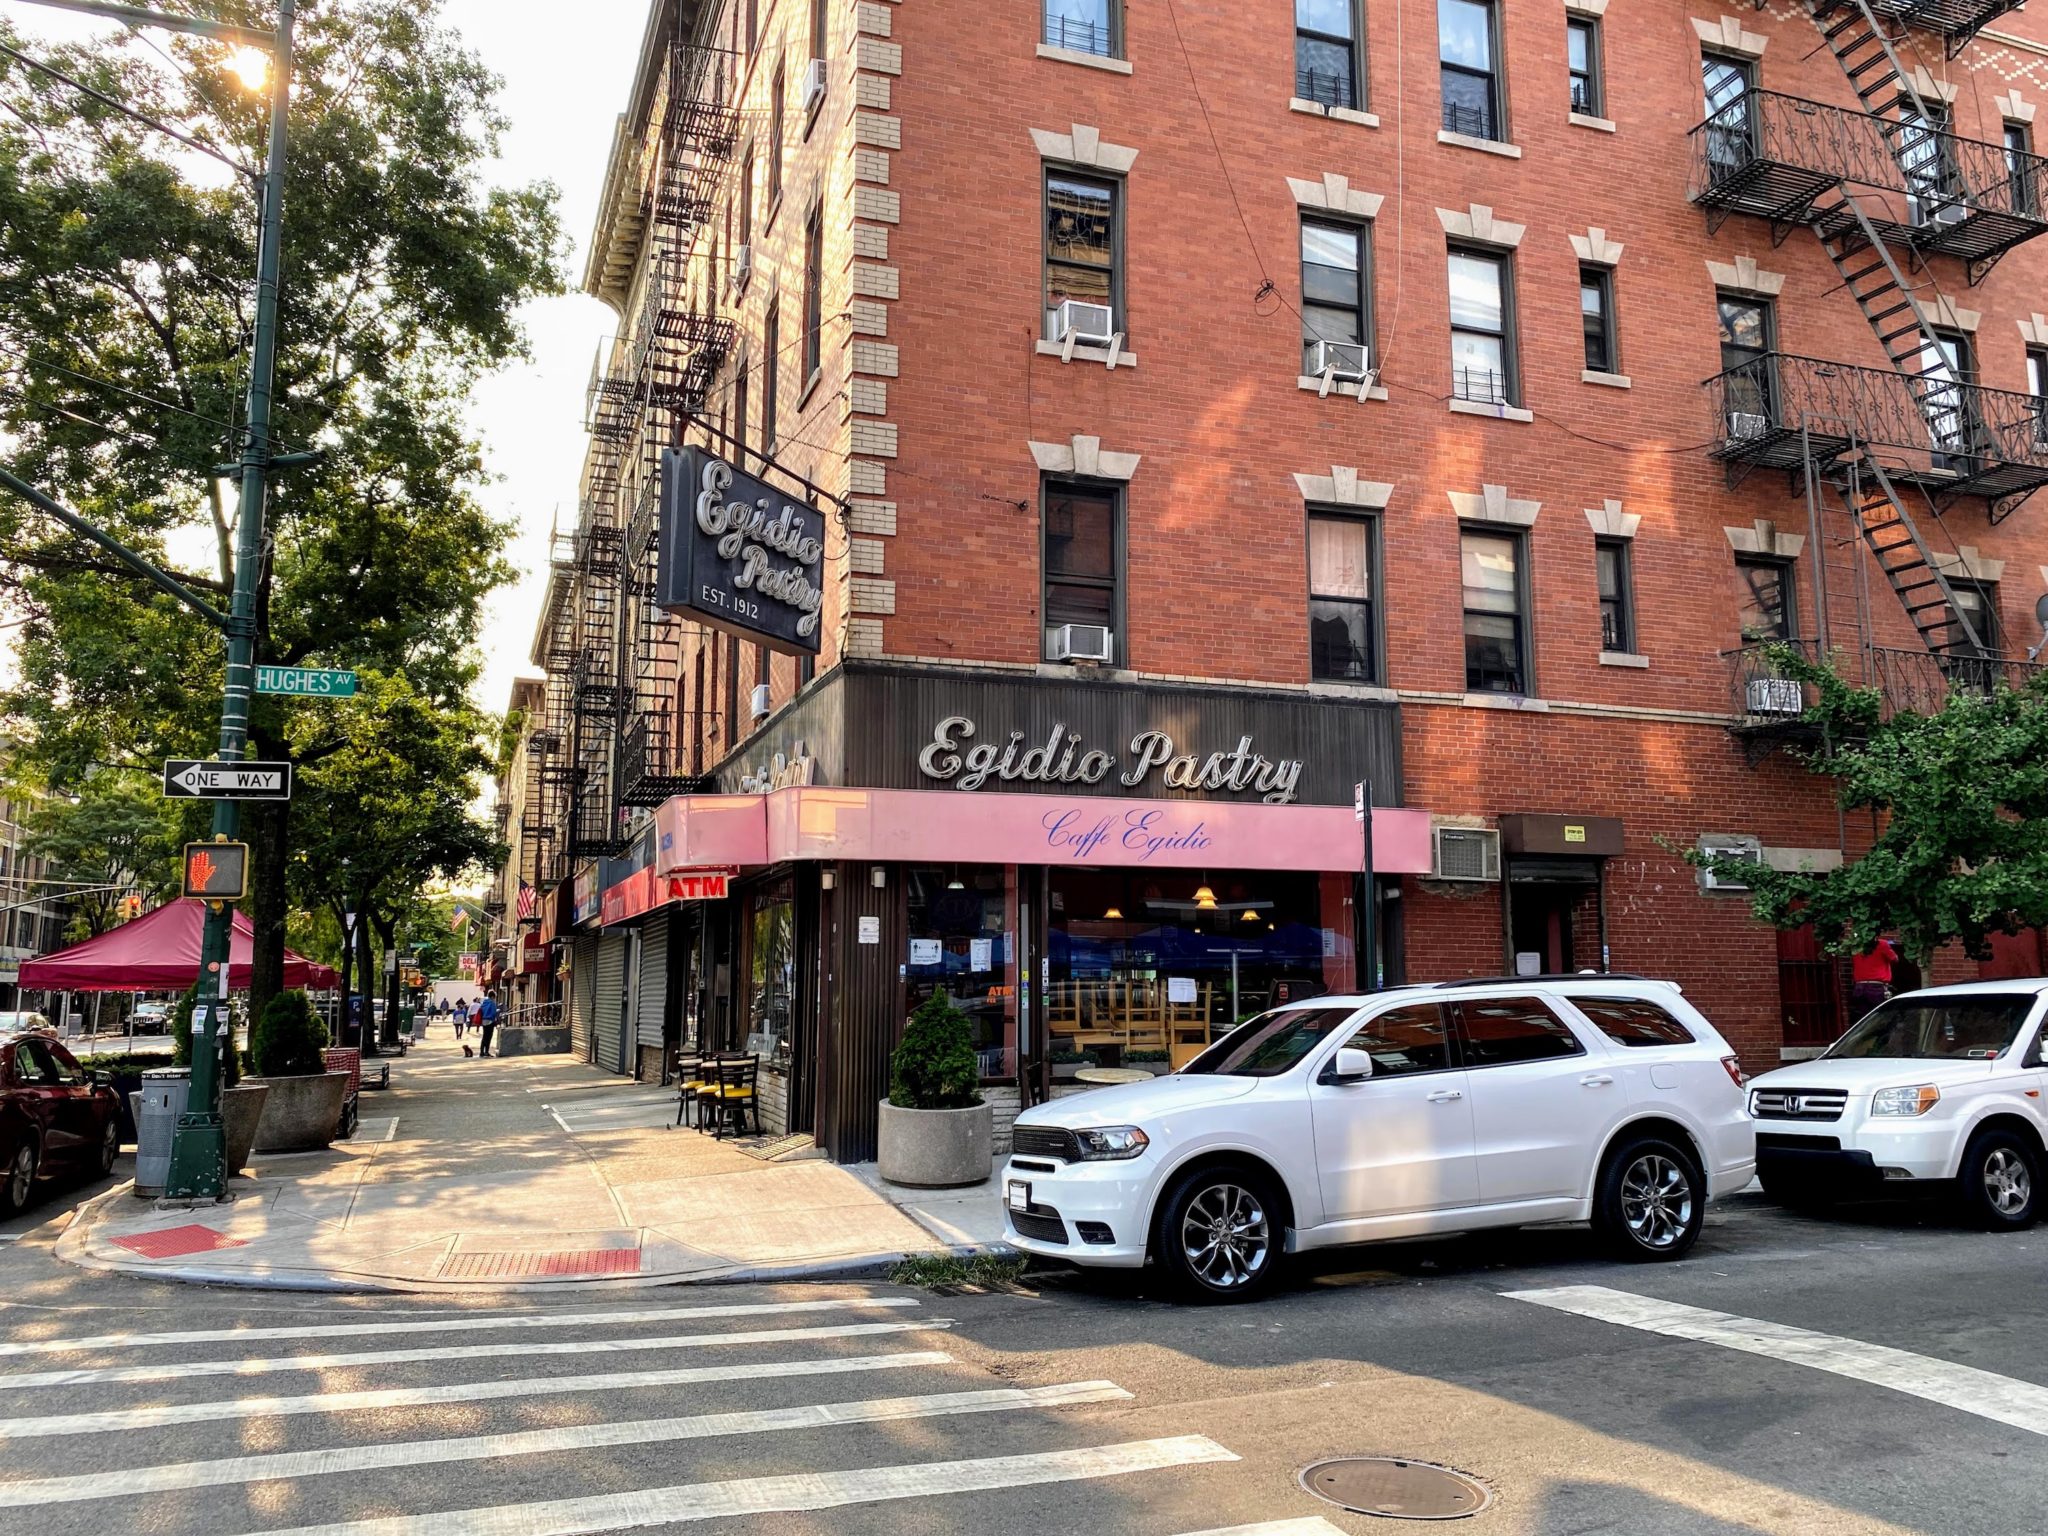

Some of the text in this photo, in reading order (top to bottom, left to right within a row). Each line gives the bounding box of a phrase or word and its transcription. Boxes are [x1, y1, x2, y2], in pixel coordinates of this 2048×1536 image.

[697, 460, 823, 565] Egidio
[702, 584, 758, 620] EST. 1912
[734, 545, 824, 637] Pastry
[256, 669, 352, 693] HUGHES AV
[918, 716, 1304, 806] Egidio Pastry
[184, 772, 274, 788] ONE WAY
[1041, 808, 1215, 862] Caffe Egidio
[668, 876, 725, 899] ATM
[988, 985, 1013, 996] ATM
